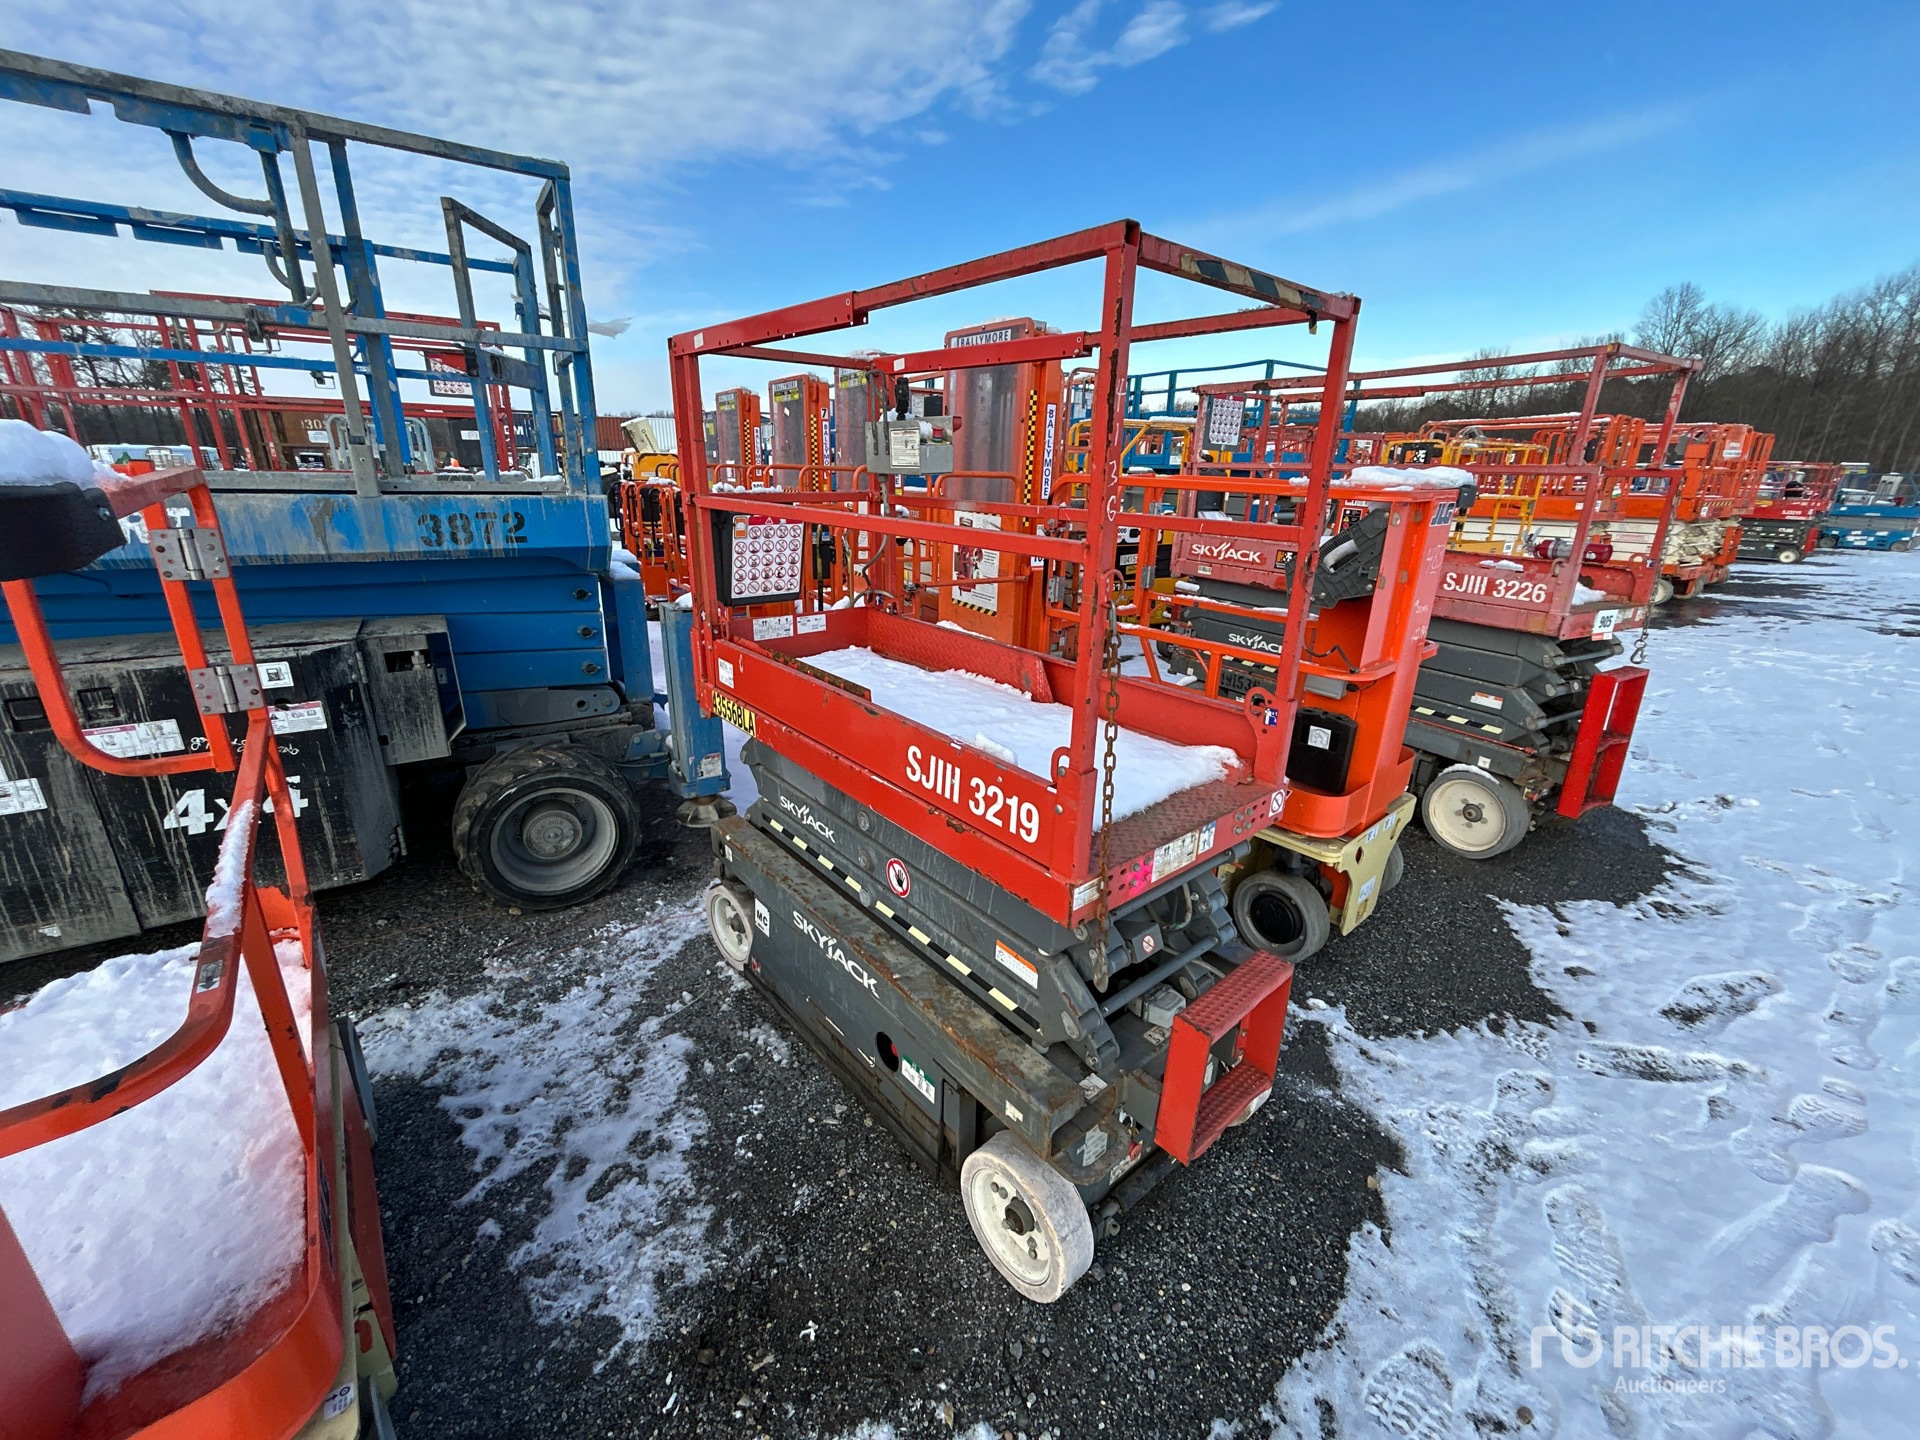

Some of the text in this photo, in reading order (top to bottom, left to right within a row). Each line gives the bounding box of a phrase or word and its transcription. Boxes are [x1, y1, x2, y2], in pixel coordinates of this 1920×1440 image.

[821, 408, 828, 418] 7
[1043, 408, 1054, 496] BALLYMORE
[418, 511, 528, 548] 3872
[1429, 501, 1456, 526] JLG
[1191, 541, 1262, 564] SKYJACK
[1443, 572, 1548, 604] SJIII 3226
[1598, 615, 1613, 629] 905
[780, 795, 836, 843] SKYJACK
[968, 776, 1040, 844] 3219
[756, 909, 768, 927] MC
[792, 910, 880, 999] SKYJACK
